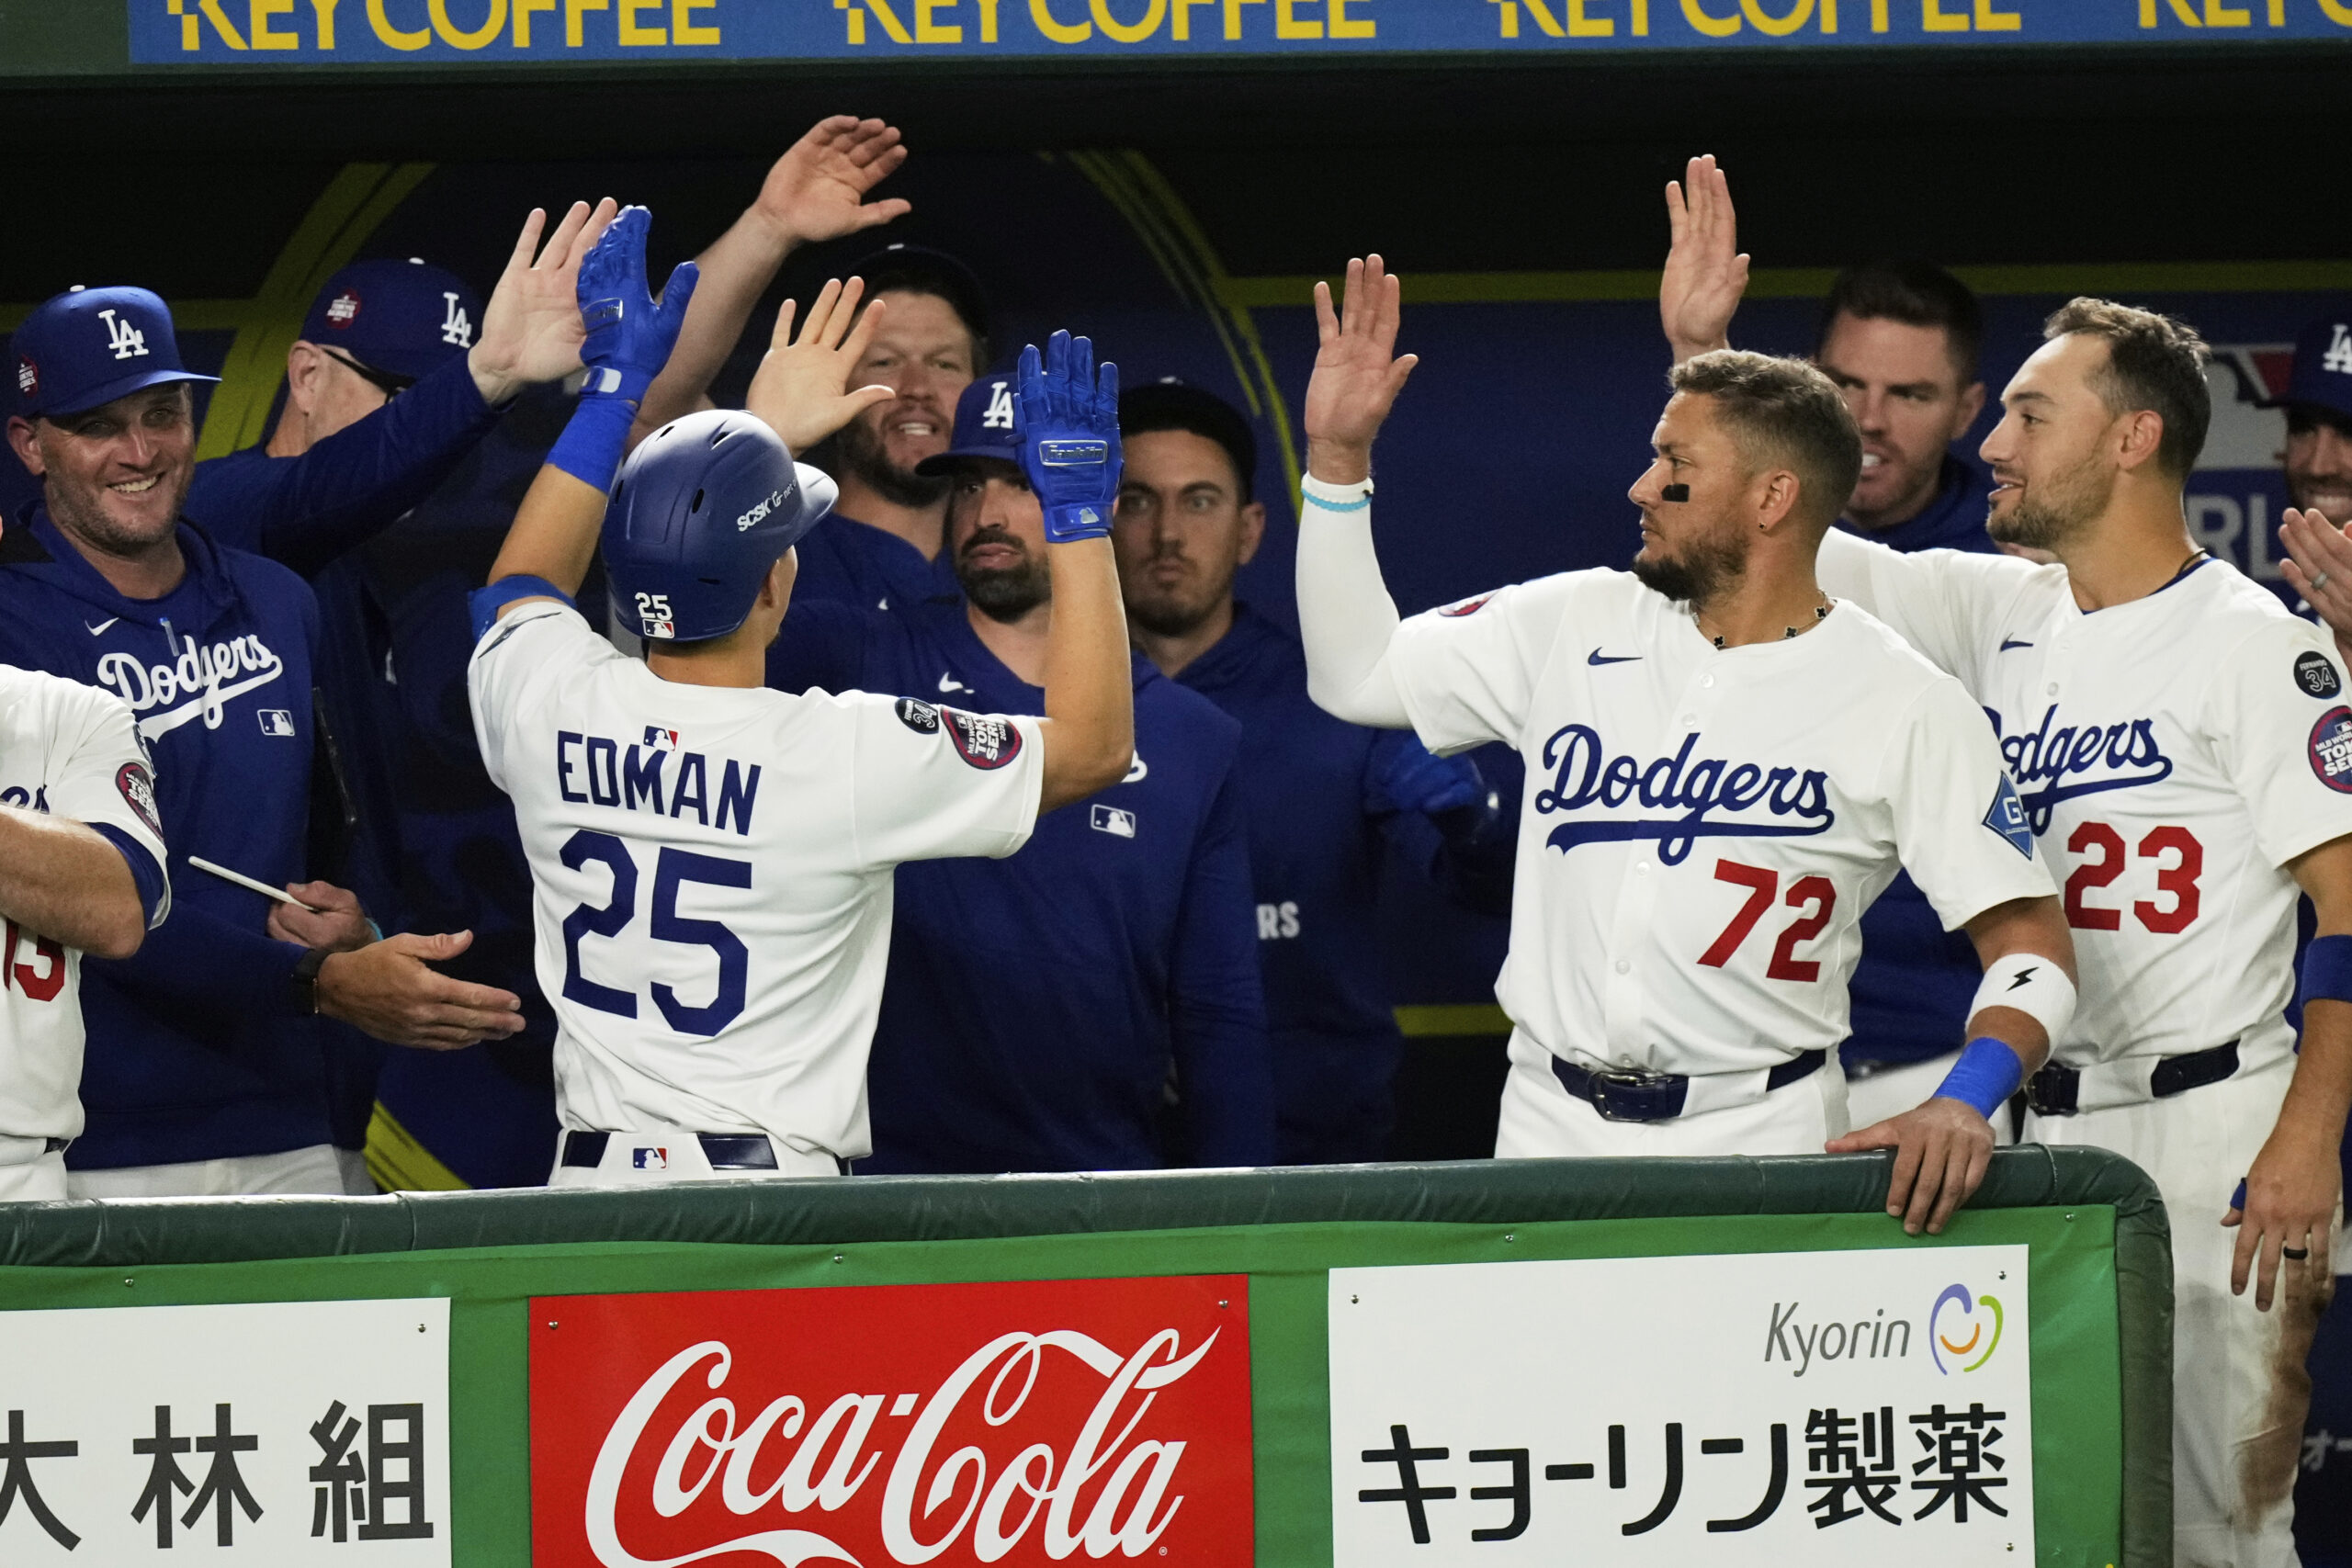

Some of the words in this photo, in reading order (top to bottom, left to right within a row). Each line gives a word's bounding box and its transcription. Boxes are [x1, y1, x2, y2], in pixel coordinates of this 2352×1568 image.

[97, 309, 149, 360] LA
[441, 291, 472, 348] LA
[635, 592, 673, 621] 25
[96, 634, 283, 743] Dodgers
[912, 703, 937, 728] 34
[2305, 667, 2336, 693] 34
[557, 729, 762, 837] EDMAN
[1535, 723, 1836, 866] Dodgers
[1696, 857, 1837, 983] 72
[2064, 820, 2203, 935] 23
[559, 828, 753, 1038] 25
[1763, 1301, 1912, 1379] Kyorin
[0, 1400, 434, 1551] 大林組
[585, 1327, 1221, 1568] Coca-Cola
[1358, 1403, 2009, 1544] キョーリン製薬
